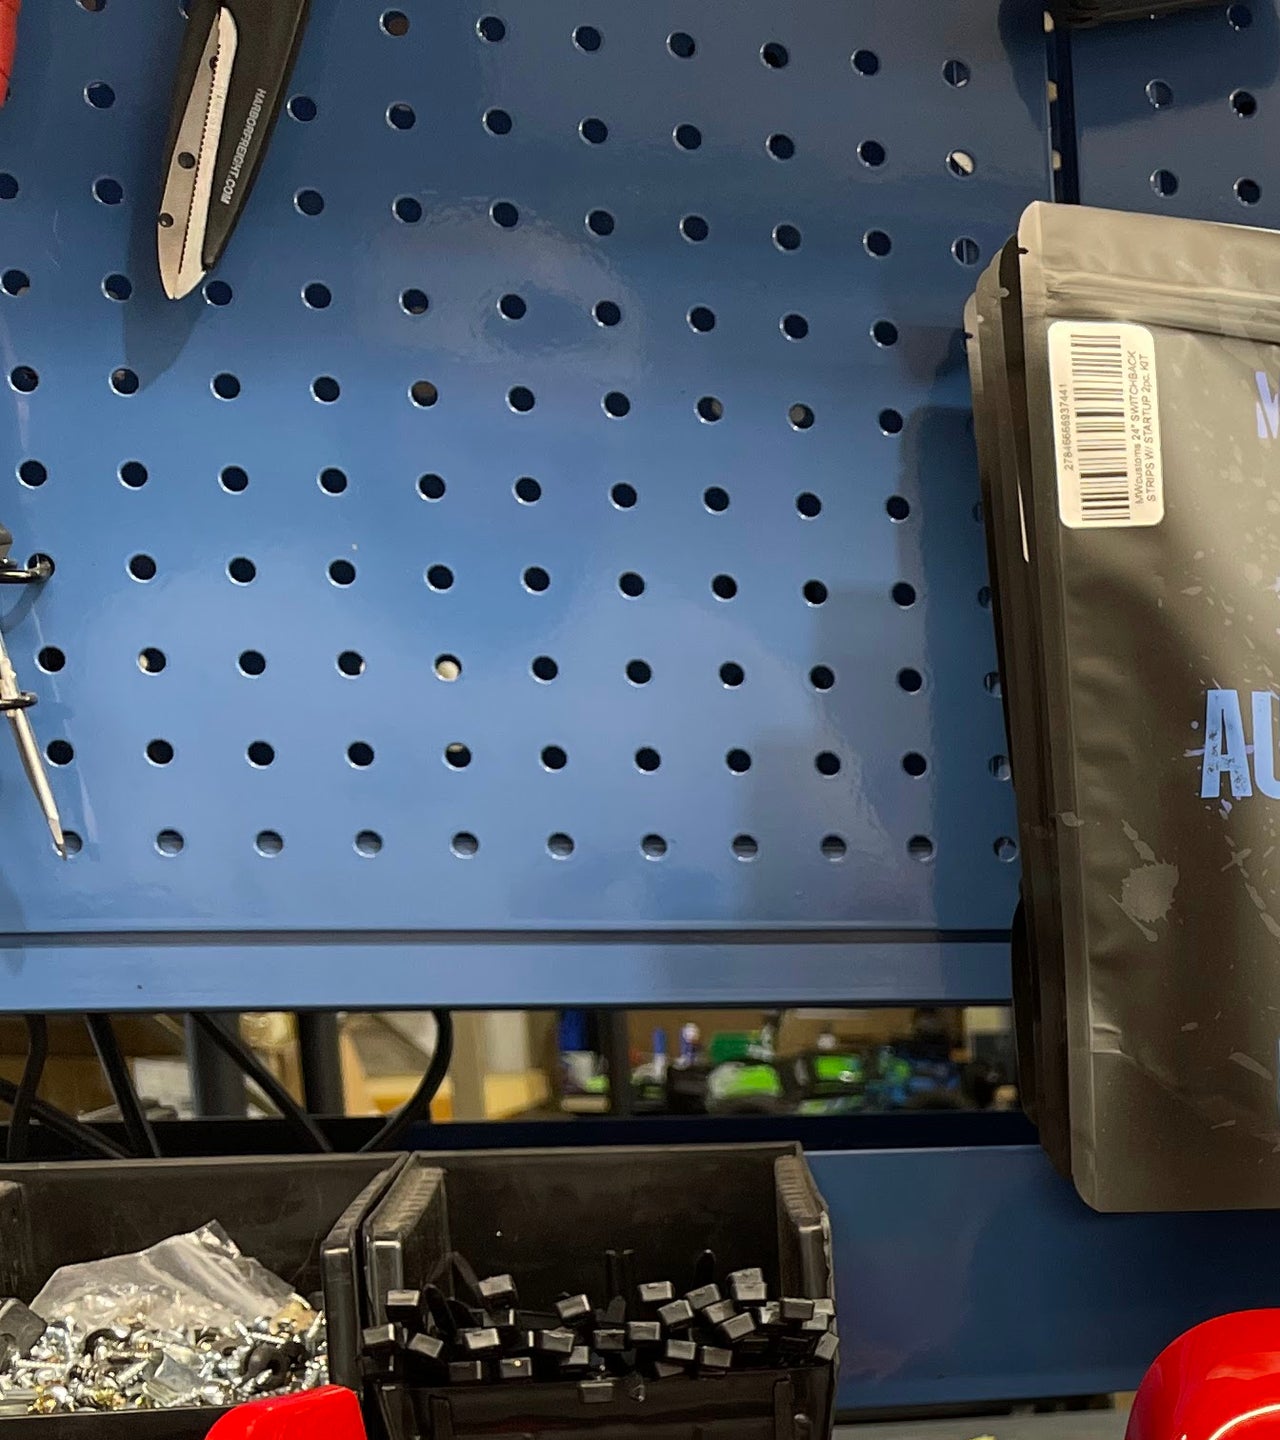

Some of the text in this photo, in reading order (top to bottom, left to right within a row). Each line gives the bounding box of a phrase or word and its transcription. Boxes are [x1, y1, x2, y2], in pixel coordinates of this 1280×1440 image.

[221, 88, 267, 204] HARBORFREIGHT.COM
[1127, 350, 1139, 422] SWITCHBACK
[1138, 354, 1149, 371] KIT
[1142, 395, 1153, 443] STARTUP
[1145, 463, 1156, 502] STRIPS
